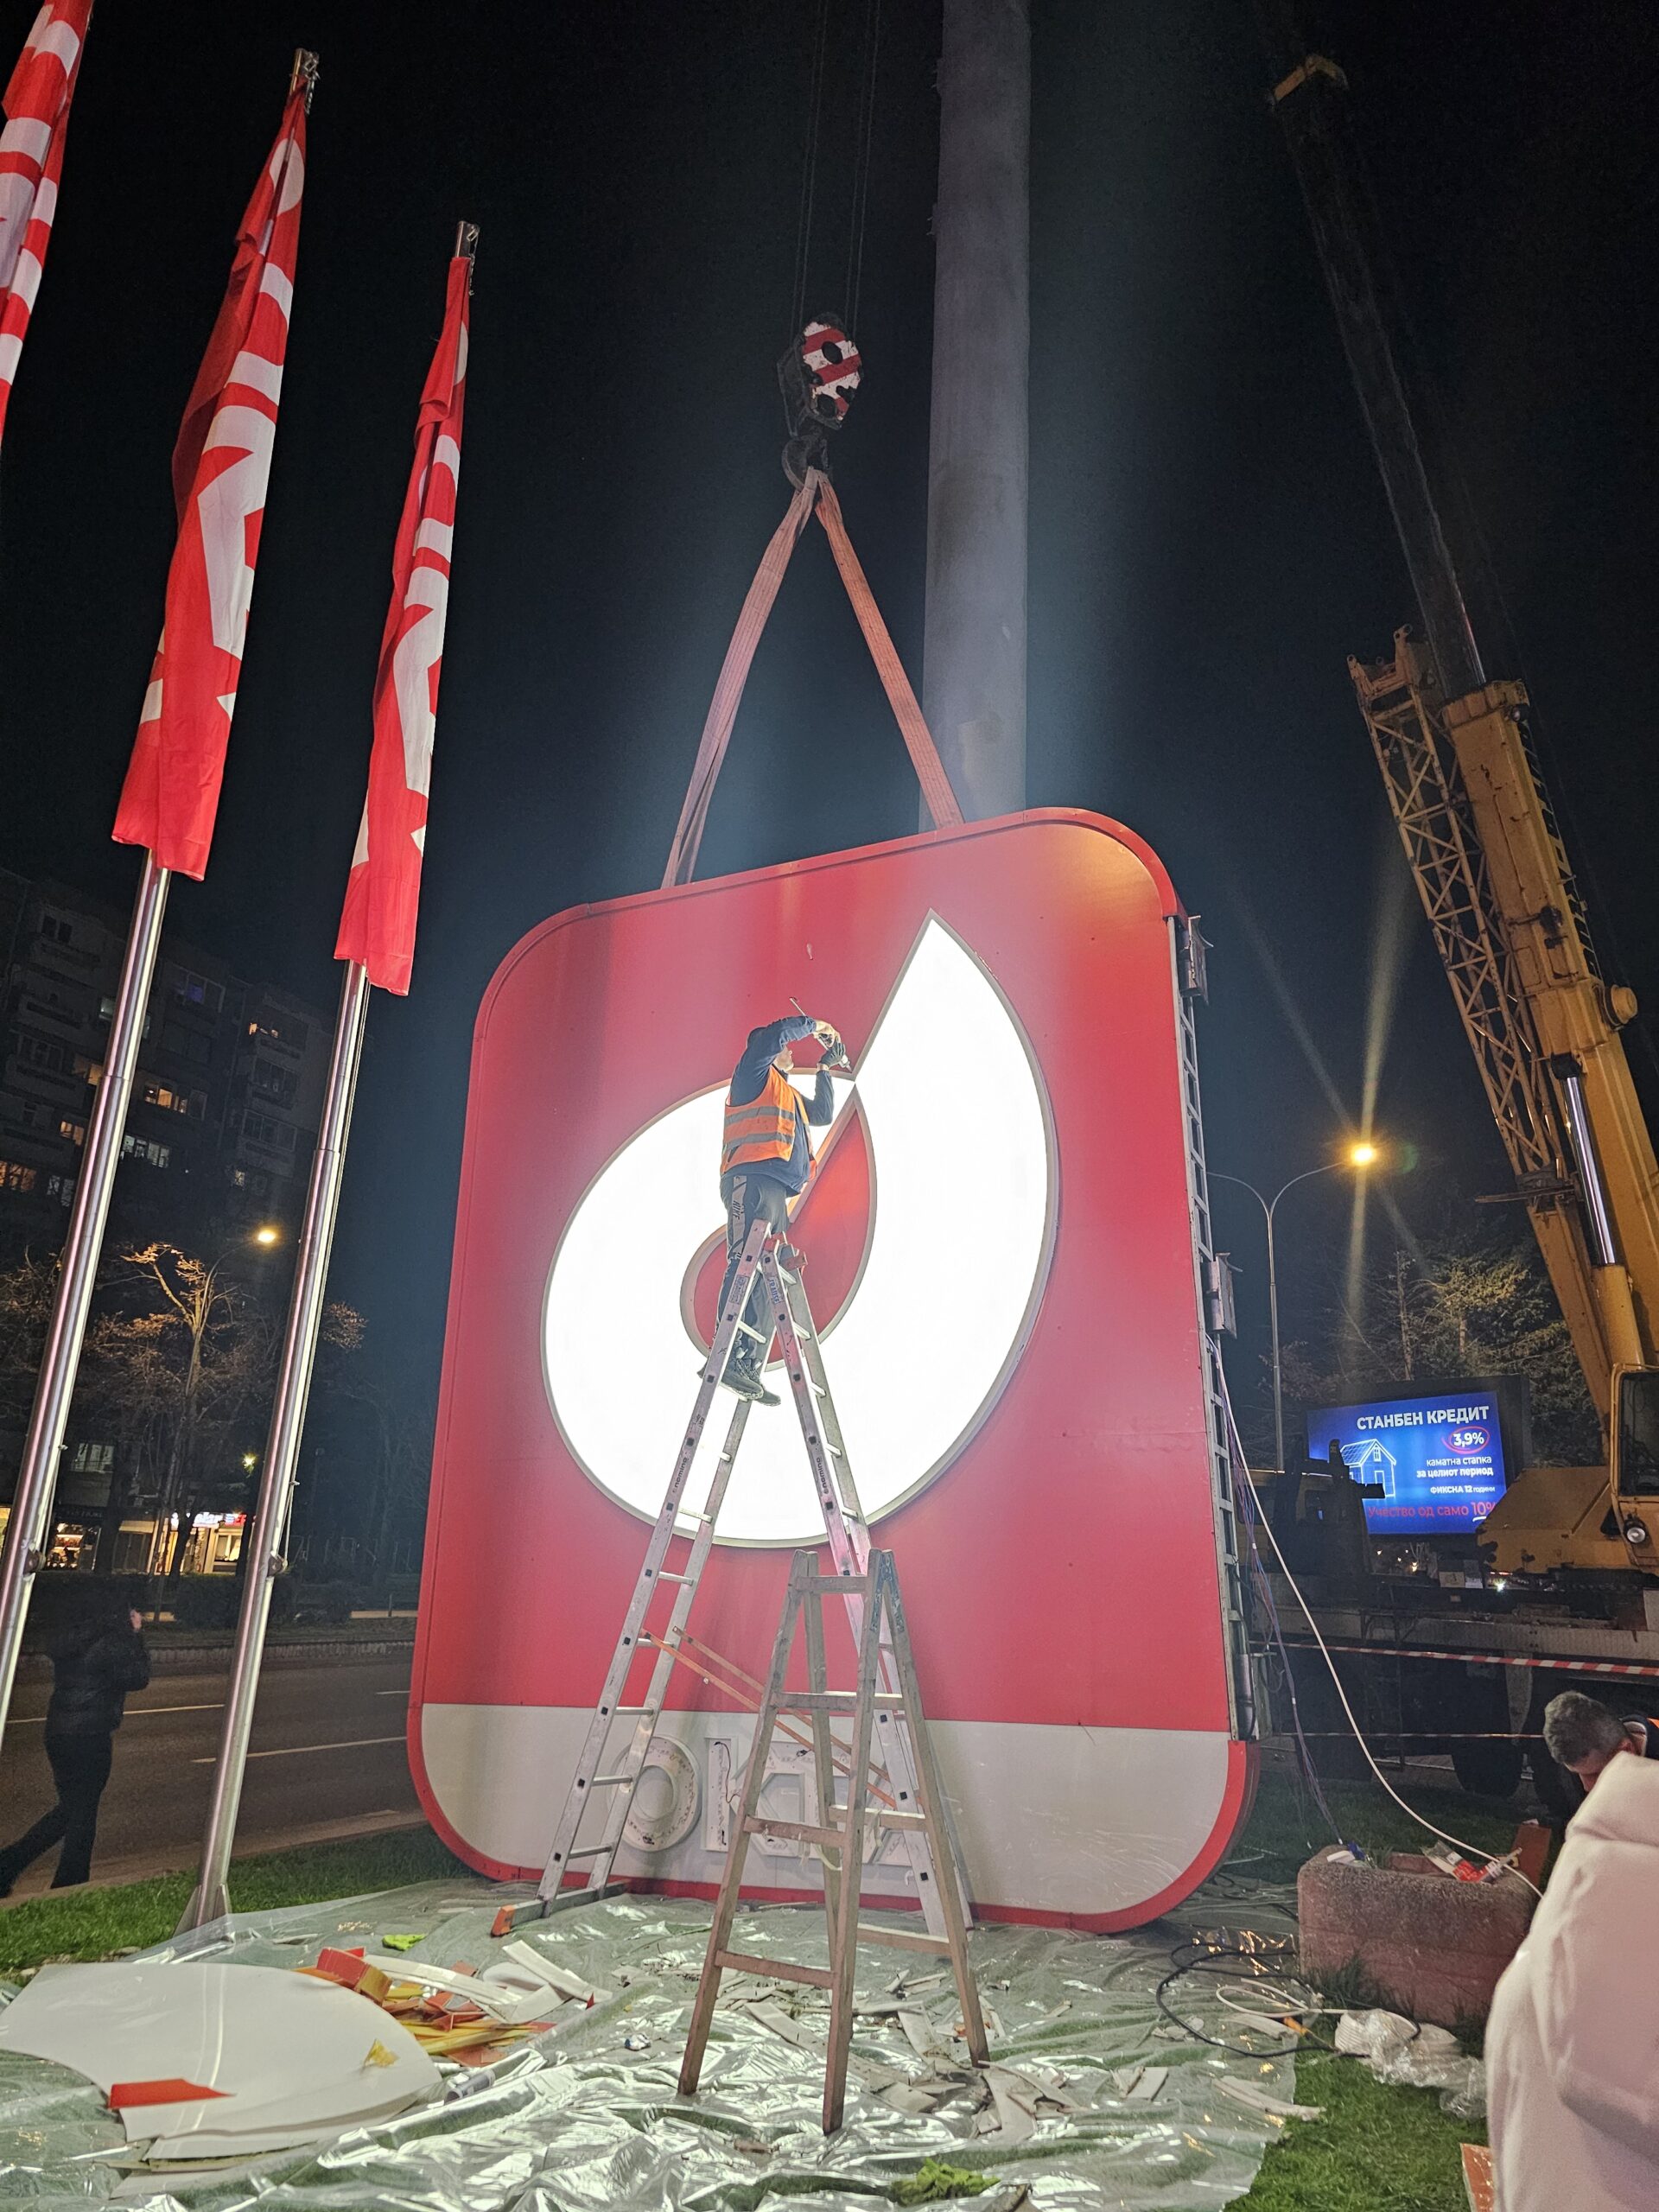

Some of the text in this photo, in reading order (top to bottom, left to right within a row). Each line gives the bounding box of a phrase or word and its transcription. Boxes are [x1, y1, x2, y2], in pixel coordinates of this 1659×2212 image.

[1357, 1405, 1490, 1430] СТАНБЕН КРЕДИТ
[1453, 1432, 1485, 1447] 3,9%
[1426, 1456, 1492, 1467] каматна стапка
[1416, 1467, 1494, 1478] за целиот период
[1430, 1485, 1465, 1495] ФИКСНА
[1465, 1484, 1473, 1493] 12
[1368, 1506, 1416, 1518] Учество
[1418, 1506, 1434, 1518] од
[1437, 1505, 1469, 1516] само
